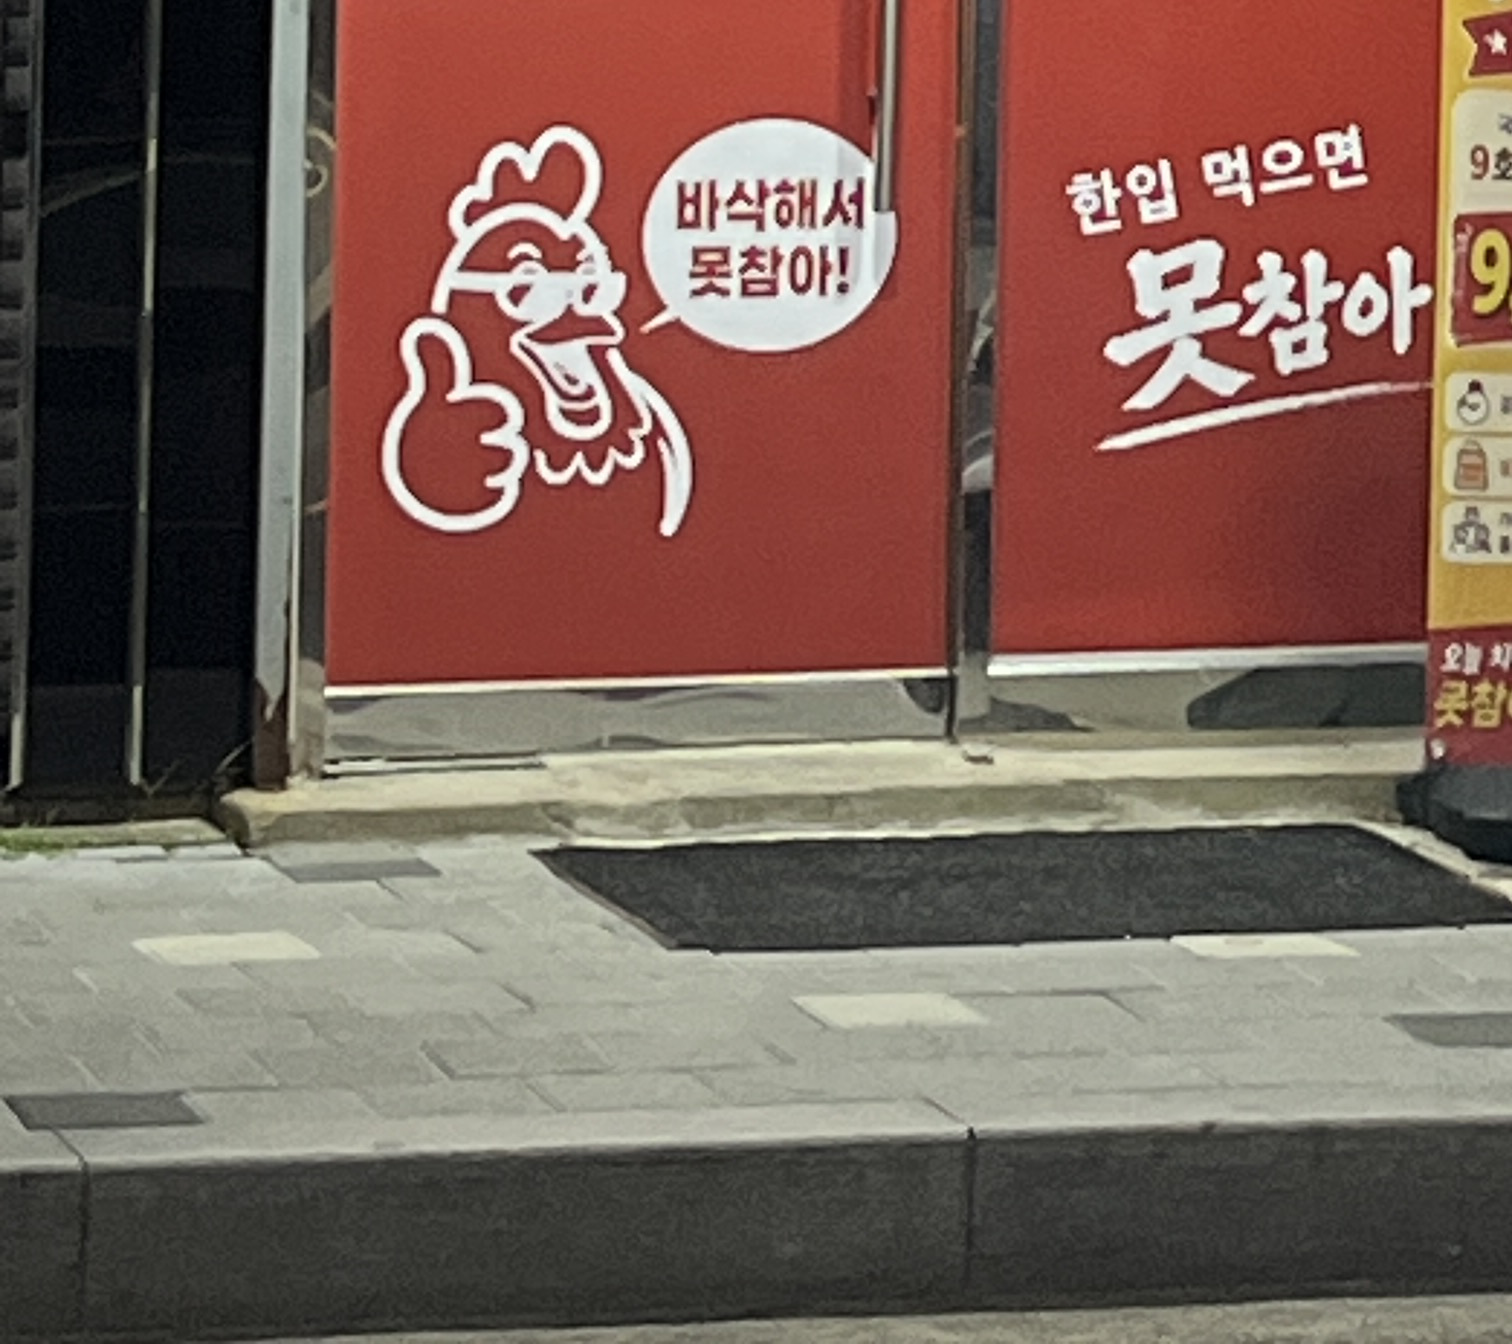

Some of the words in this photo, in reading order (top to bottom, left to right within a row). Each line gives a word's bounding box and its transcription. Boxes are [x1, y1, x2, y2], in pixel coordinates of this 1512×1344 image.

[675, 176, 866, 232] 바삭해서
[1065, 158, 1181, 236] 한입
[1200, 123, 1369, 208] 먹으면
[687, 245, 850, 300] 못참아!
[1103, 238, 1434, 412] 못참아
[1439, 643, 1483, 676] 오늘
